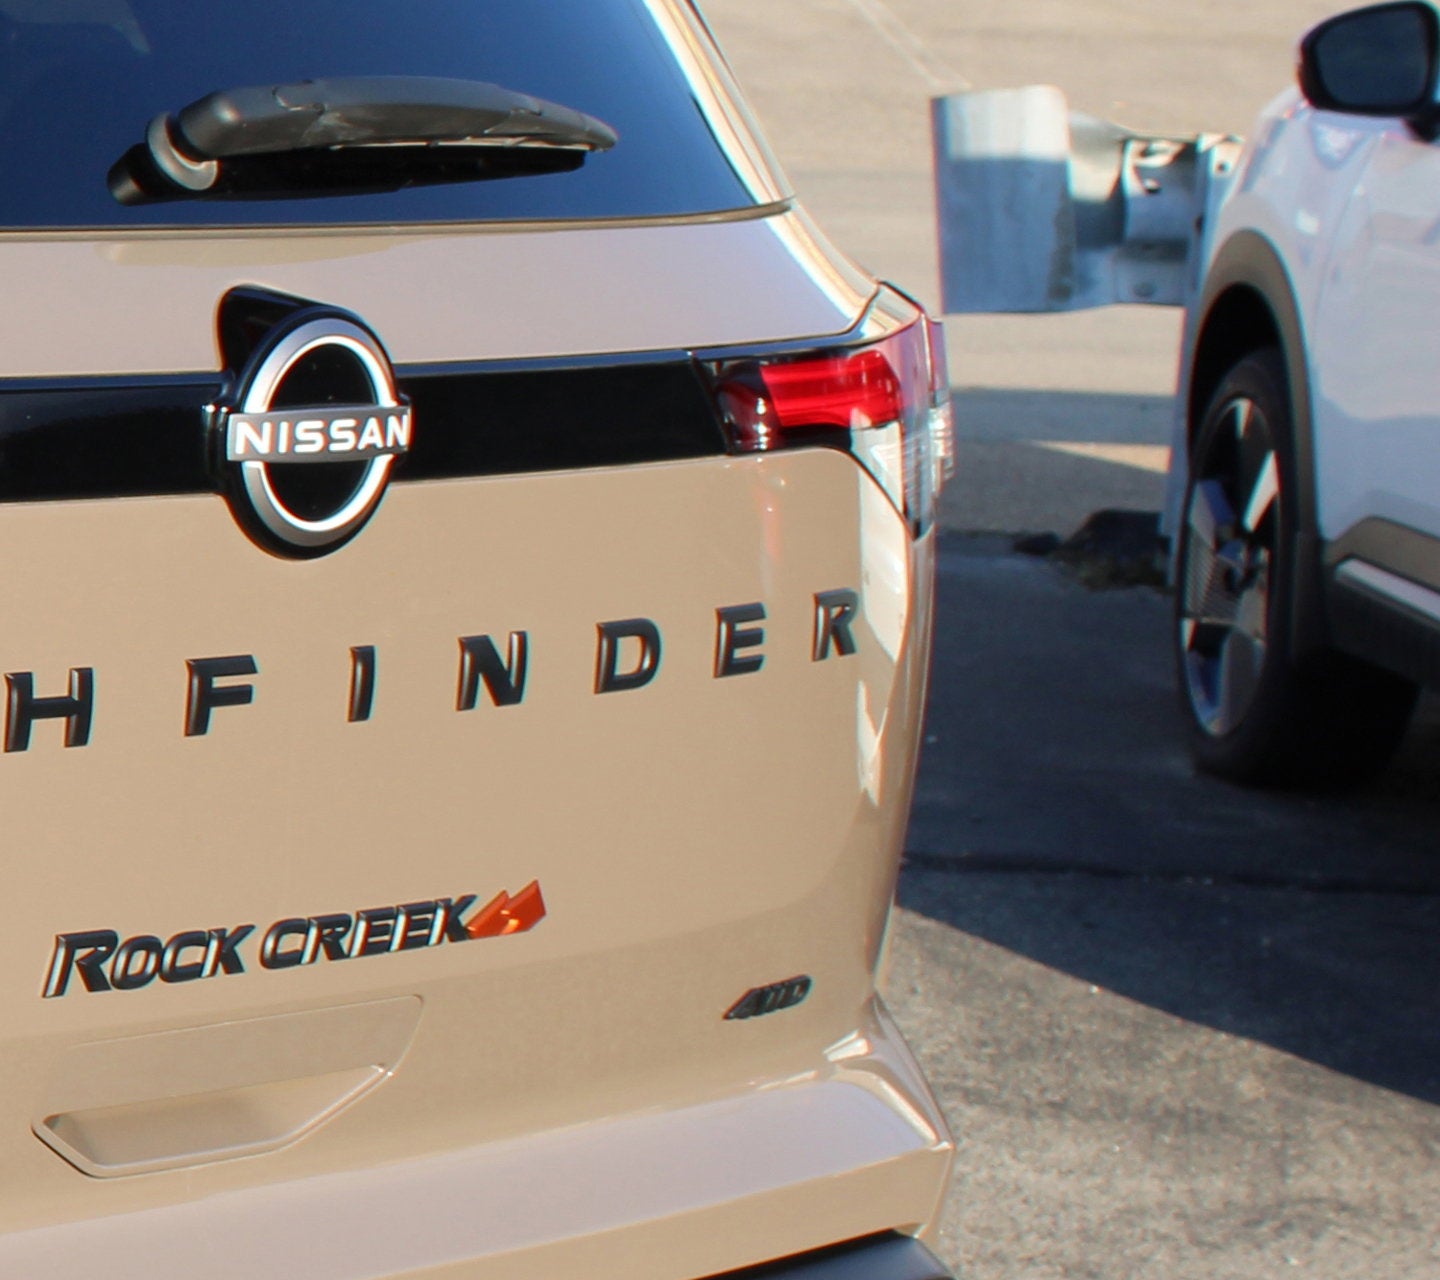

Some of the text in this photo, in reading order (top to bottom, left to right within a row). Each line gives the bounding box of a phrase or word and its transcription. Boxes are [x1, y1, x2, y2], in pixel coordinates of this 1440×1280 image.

[234, 414, 410, 455] NISSAN
[41, 894, 479, 999] ROCK CREEK
